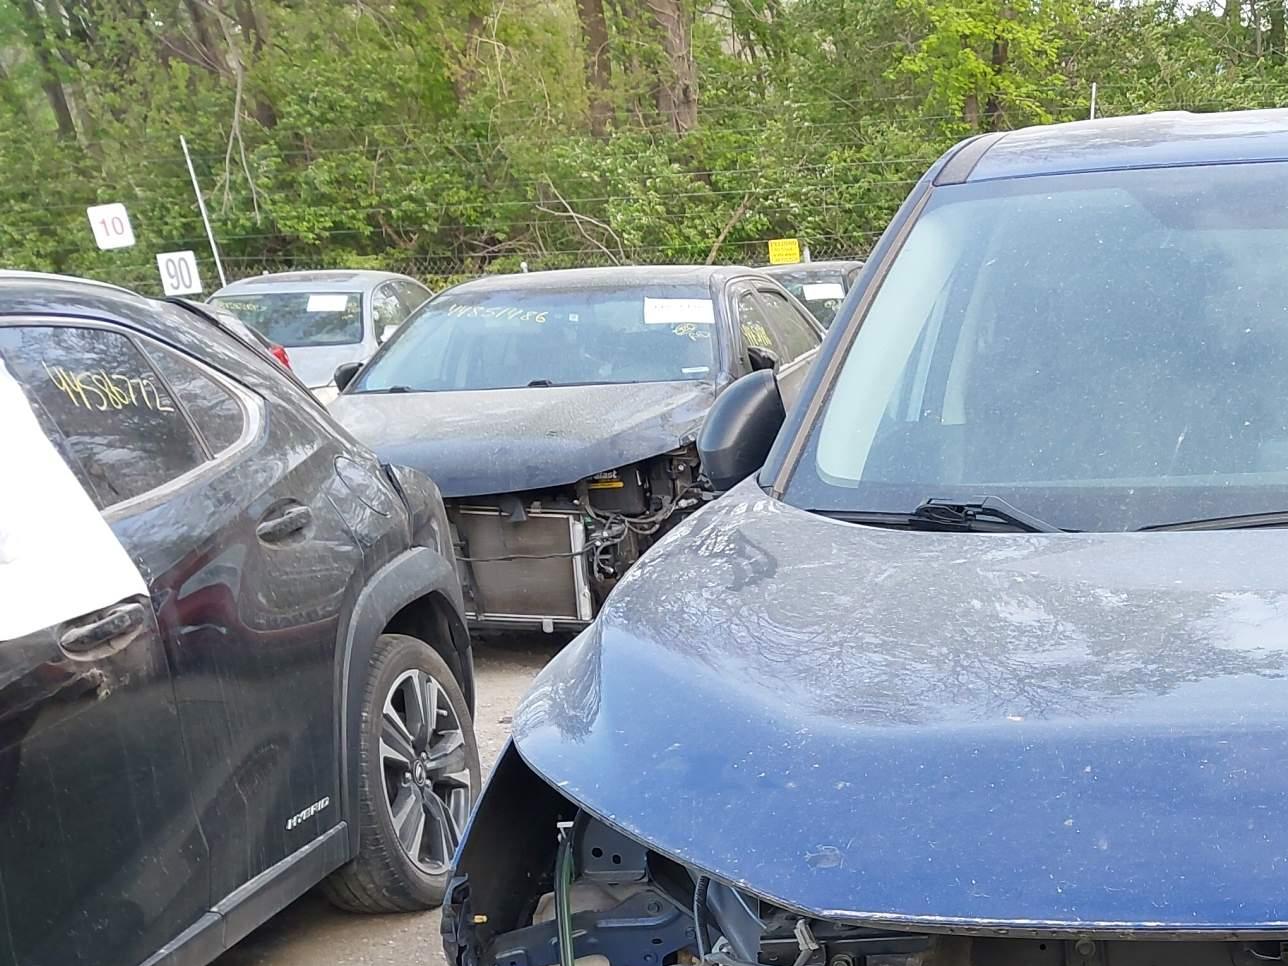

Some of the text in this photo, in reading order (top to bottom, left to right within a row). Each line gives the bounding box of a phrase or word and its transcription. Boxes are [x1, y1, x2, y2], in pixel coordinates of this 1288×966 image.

[99, 216, 125, 237] 10
[165, 256, 193, 291] 90
[286, 796, 330, 830] HYBRID
